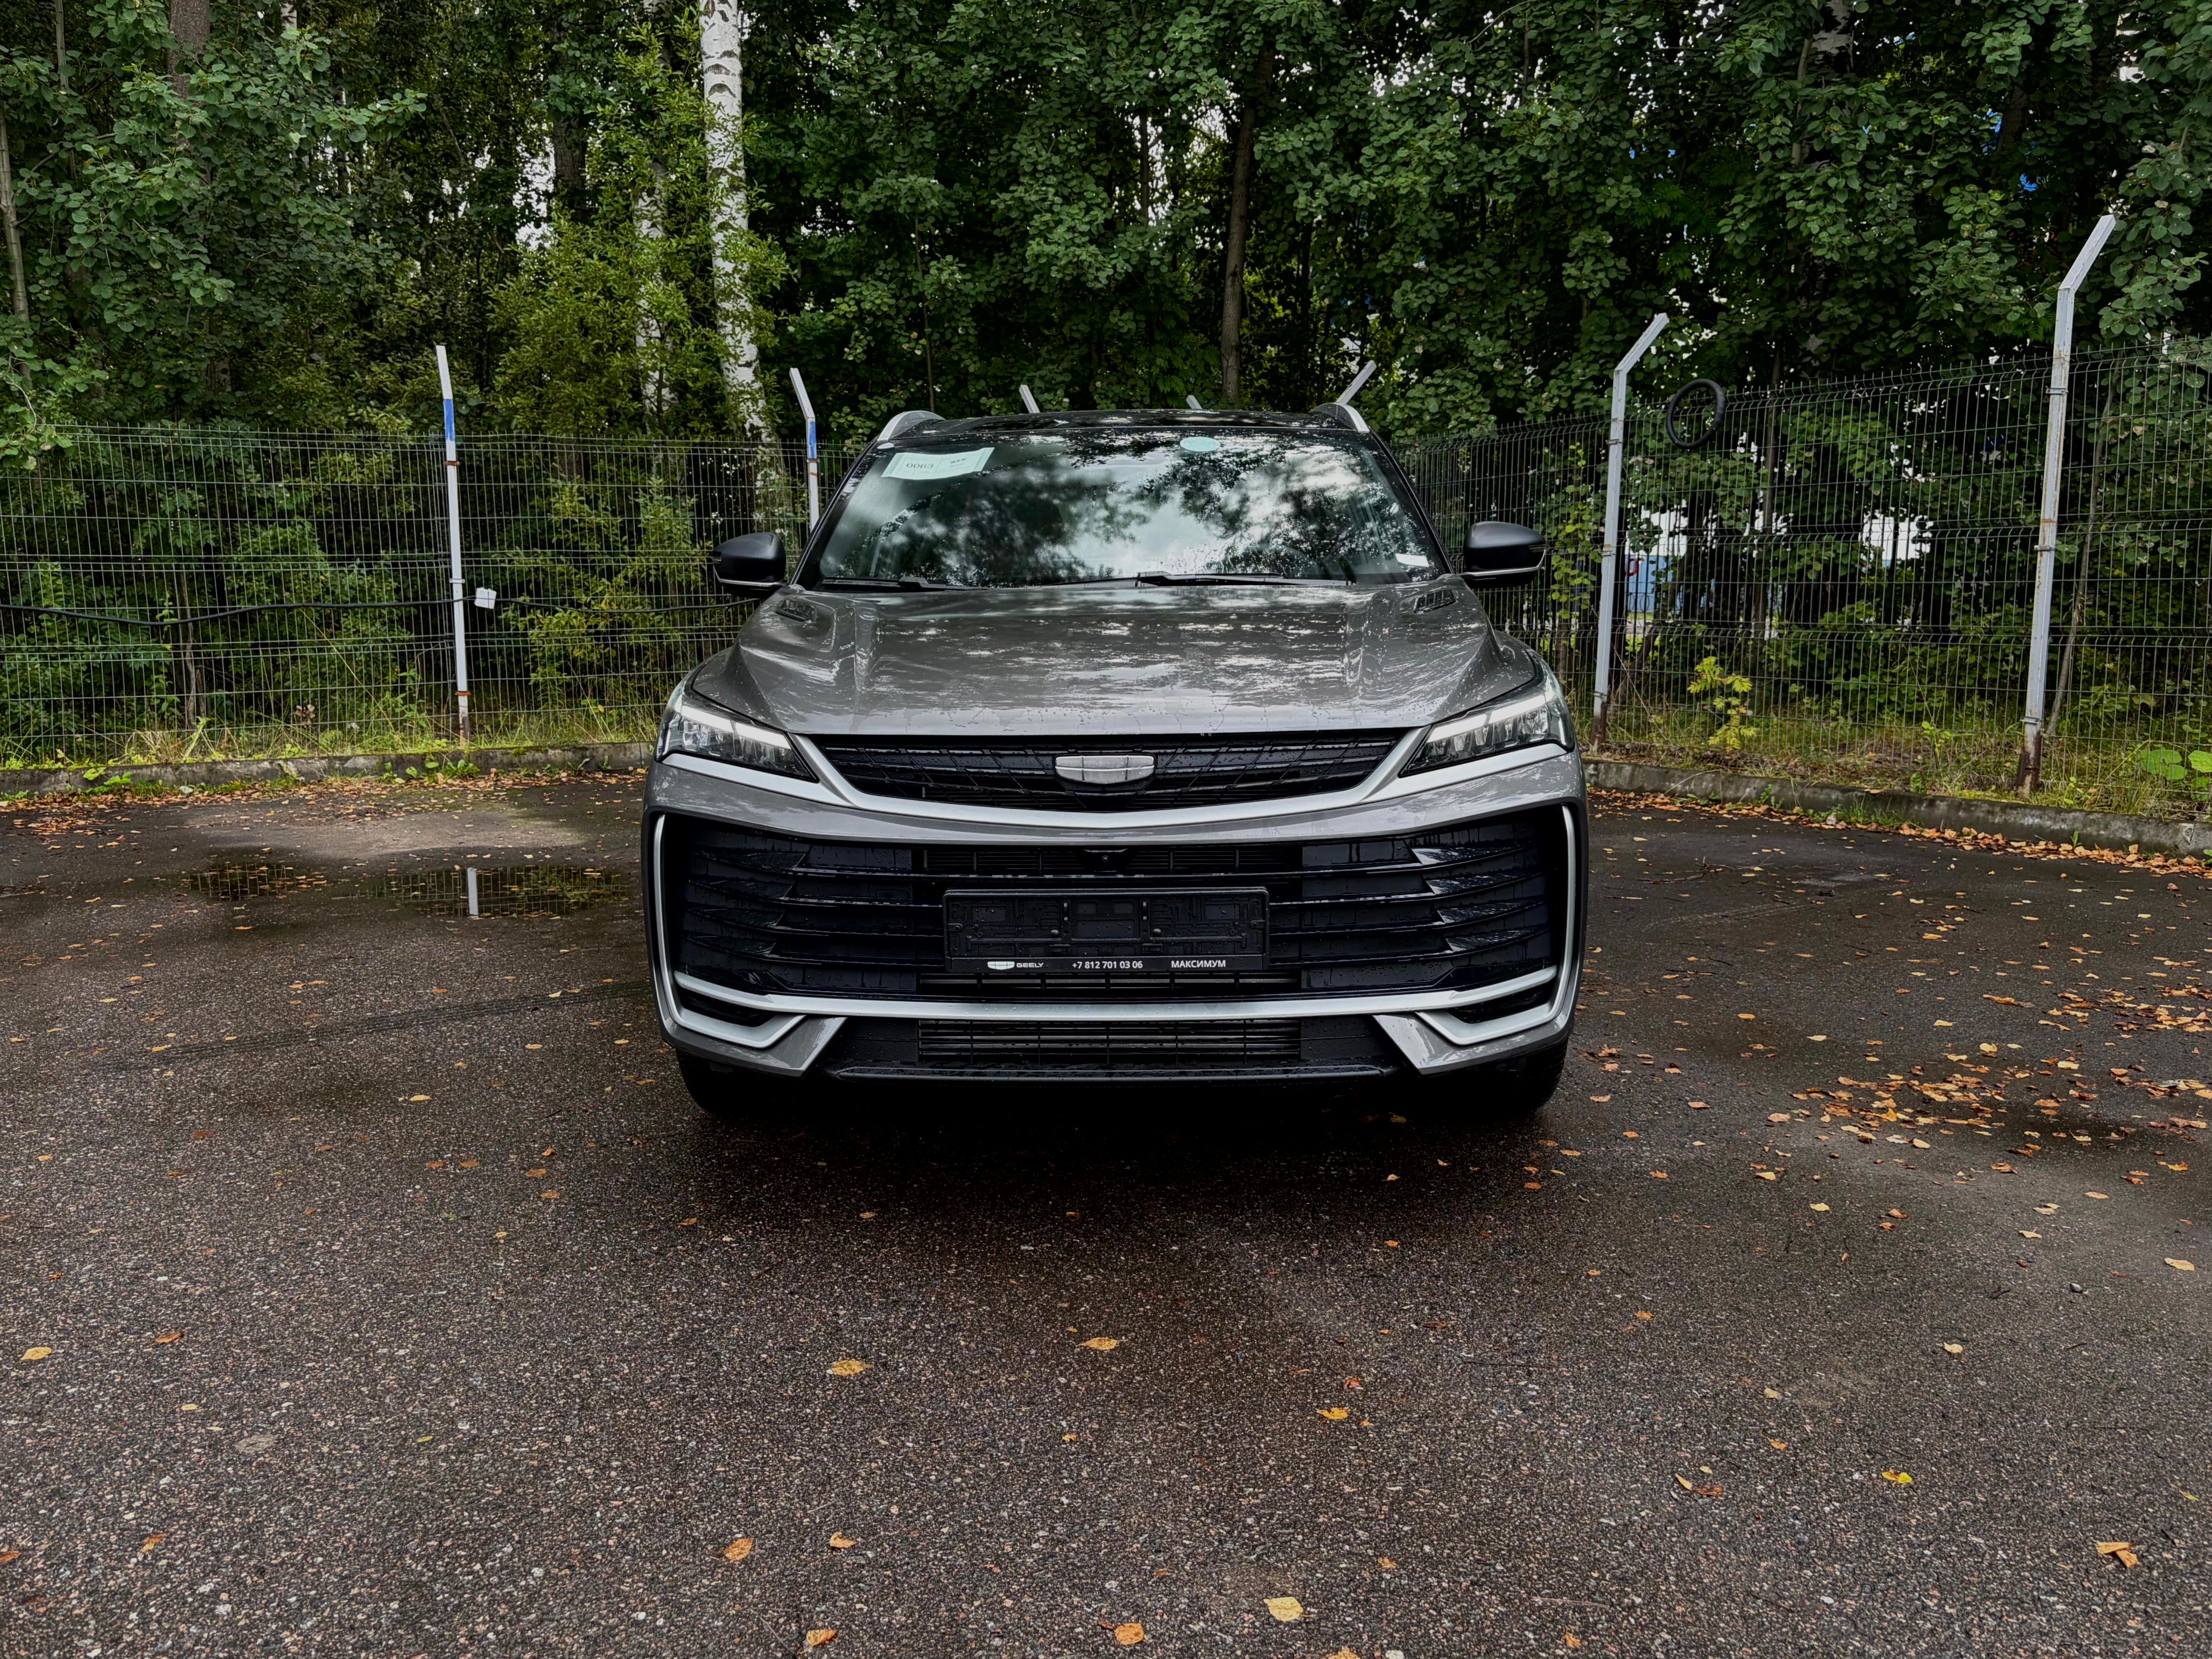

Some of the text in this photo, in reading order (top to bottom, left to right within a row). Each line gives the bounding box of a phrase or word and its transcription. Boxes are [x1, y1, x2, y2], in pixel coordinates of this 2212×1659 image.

[1102, 961, 1117, 969] 701
[1119, 961, 1130, 969] 03
[1132, 960, 1143, 968] 06
[1171, 960, 1226, 968] МАКСИМУМ
